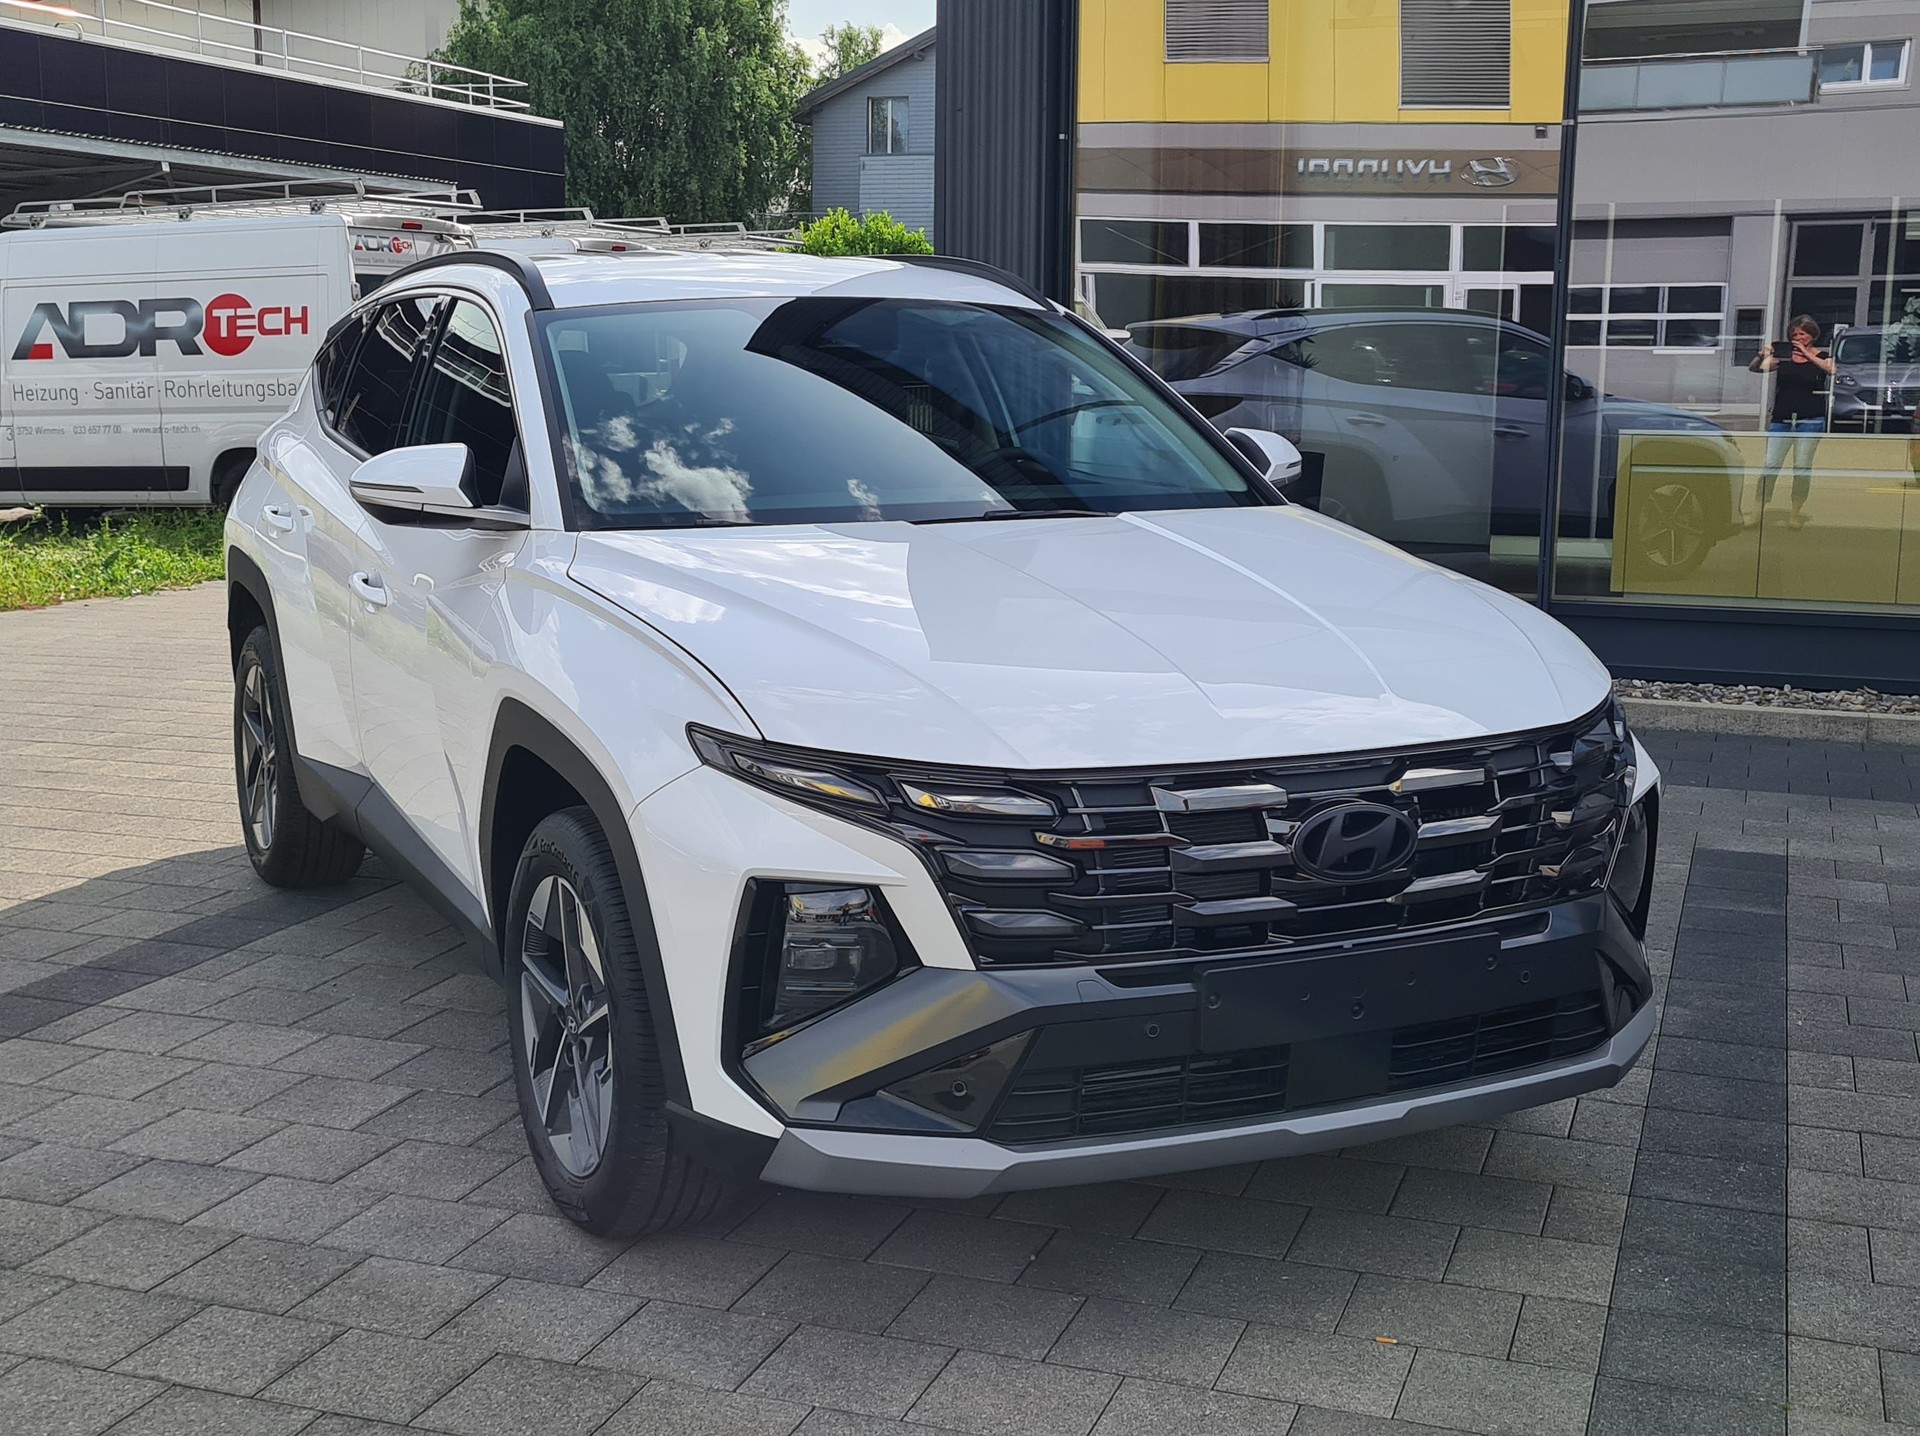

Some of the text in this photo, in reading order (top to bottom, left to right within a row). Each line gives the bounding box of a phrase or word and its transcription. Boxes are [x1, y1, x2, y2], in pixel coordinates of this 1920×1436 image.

[13, 378, 298, 406] Heizung Sanitär Rohrleitungsba
[73, 426, 86, 435] 033
[88, 426, 101, 434] 657
[103, 425, 111, 434] 77
[113, 425, 121, 434] 00
